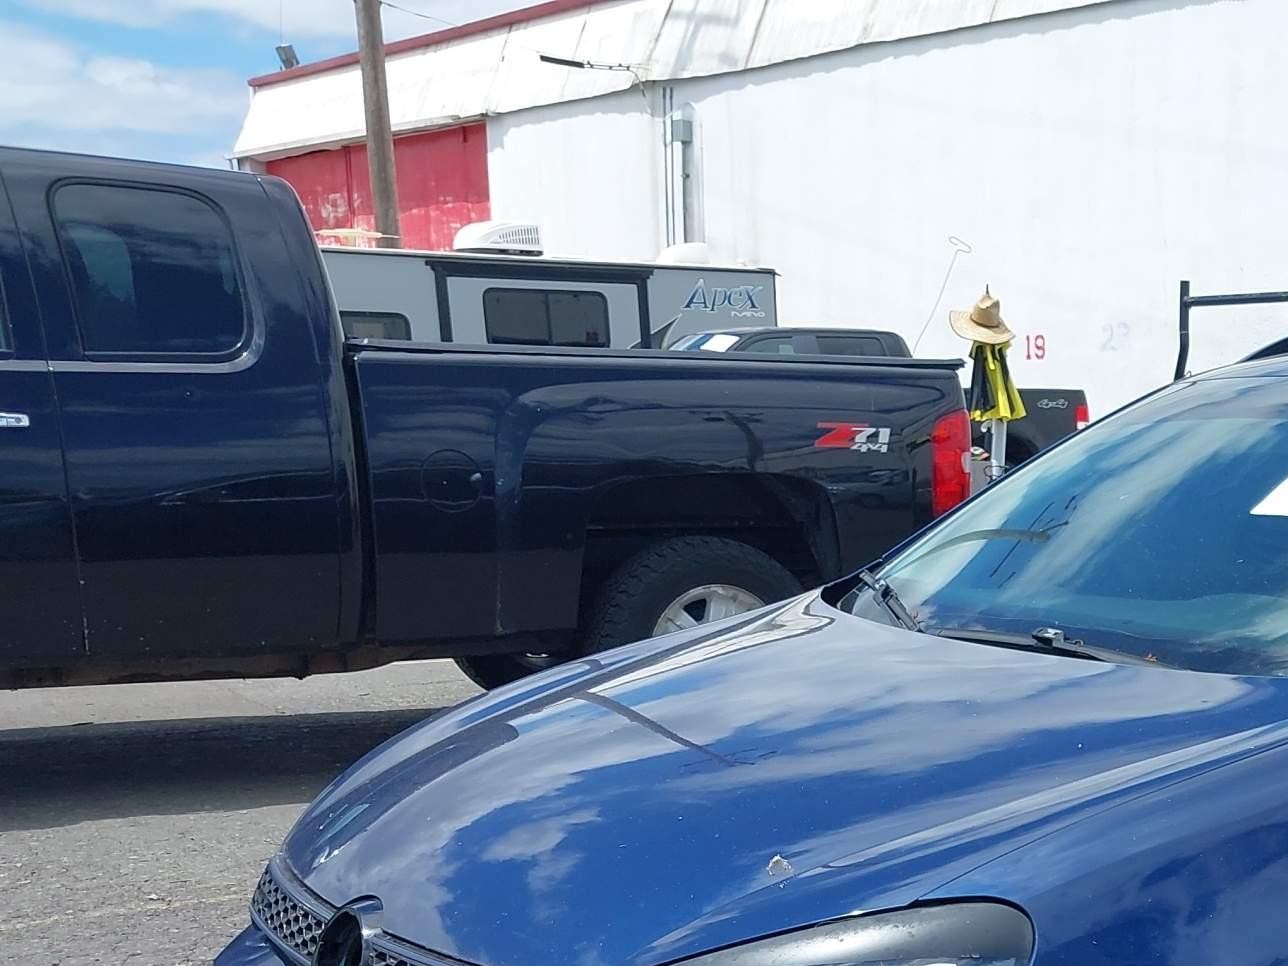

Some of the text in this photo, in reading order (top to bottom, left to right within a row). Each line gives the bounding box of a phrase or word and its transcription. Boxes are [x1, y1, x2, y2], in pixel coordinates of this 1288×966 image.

[681, 278, 764, 313] Apex
[1025, 334, 1046, 360] 19
[814, 420, 891, 449] Z71
[849, 443, 889, 453] 4x4
